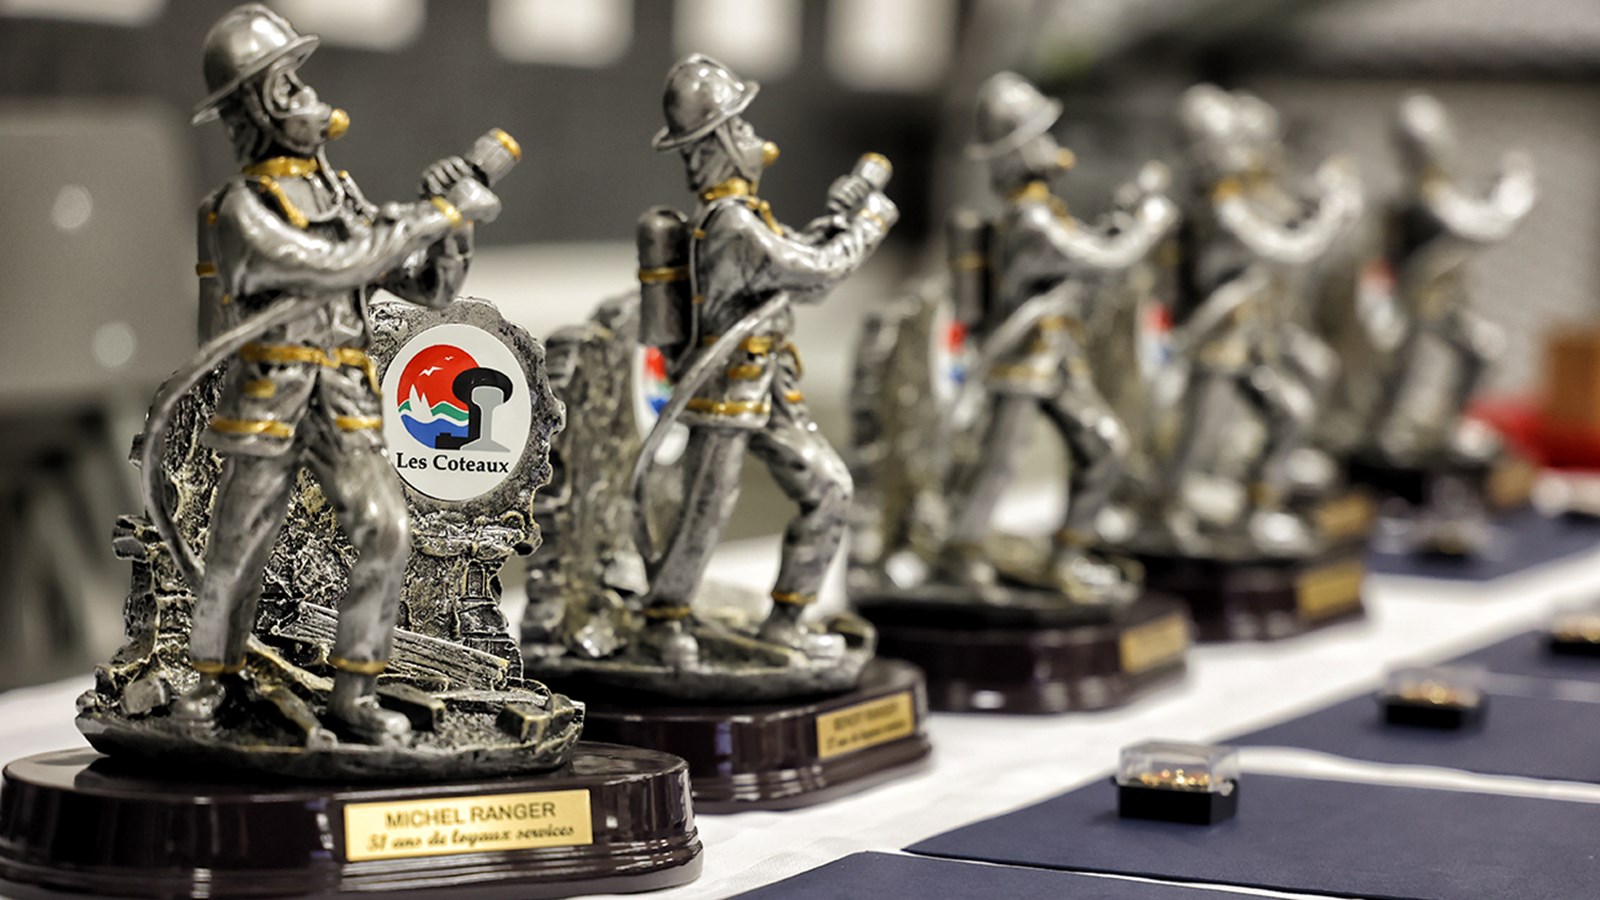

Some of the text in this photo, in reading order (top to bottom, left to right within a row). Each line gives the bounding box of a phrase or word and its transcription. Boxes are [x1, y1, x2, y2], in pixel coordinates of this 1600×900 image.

[396, 452, 509, 473] Les Coteaux
[385, 802, 556, 829] MICHEL RANGER
[392, 838, 422, 849] ans
[428, 830, 446, 846] de
[452, 828, 511, 847] loyaux
[516, 823, 575, 839] services
